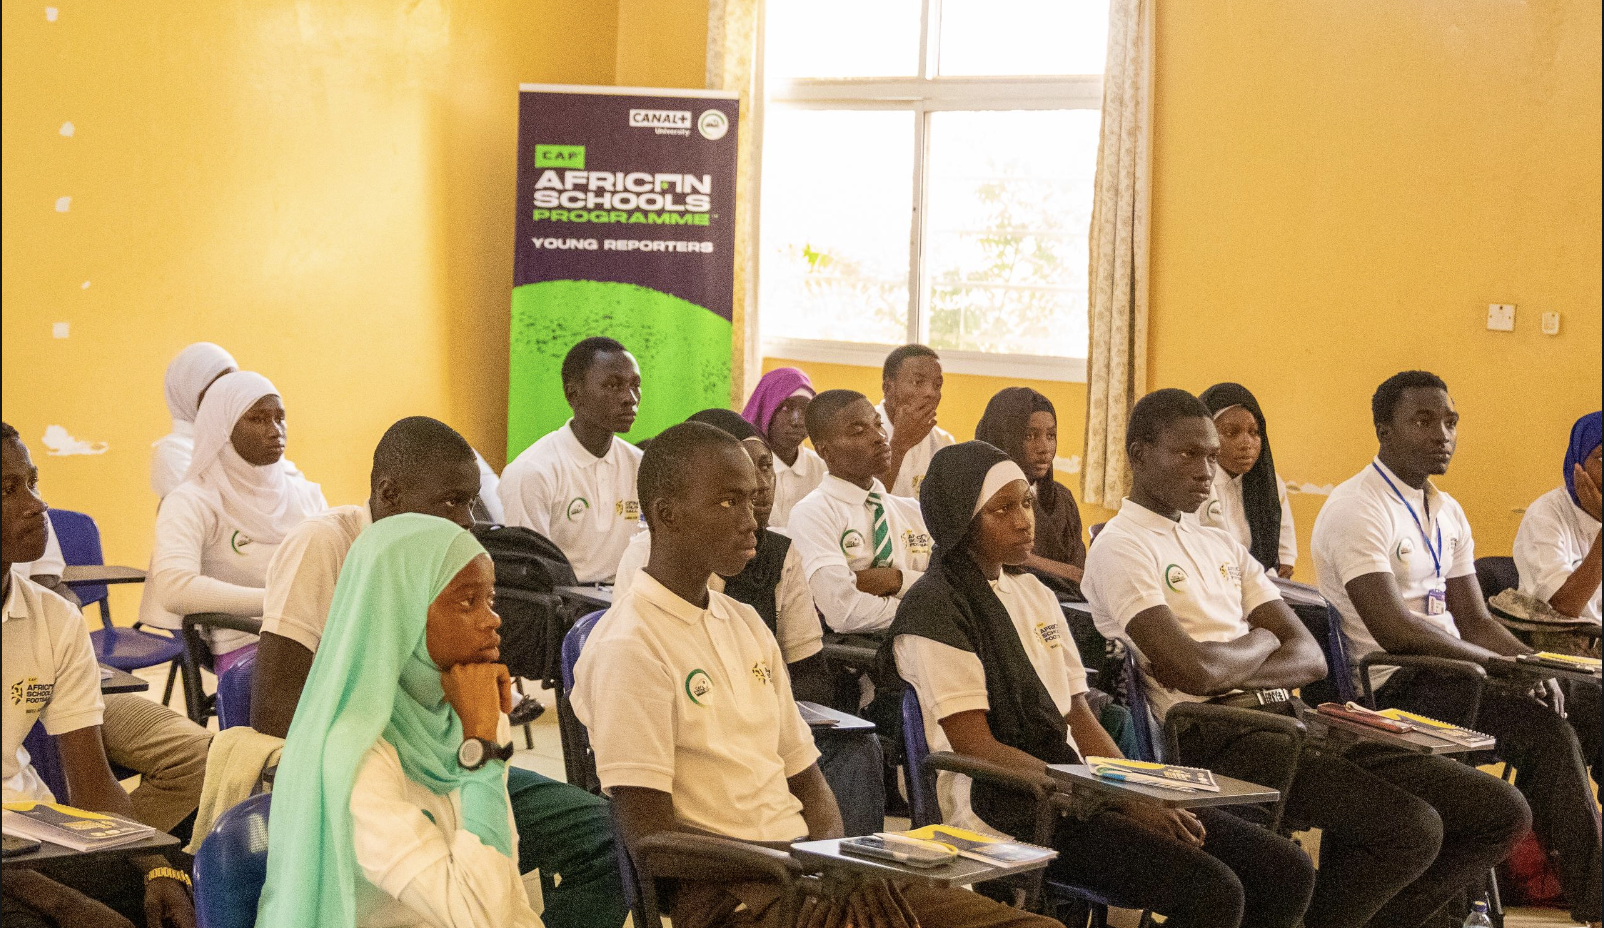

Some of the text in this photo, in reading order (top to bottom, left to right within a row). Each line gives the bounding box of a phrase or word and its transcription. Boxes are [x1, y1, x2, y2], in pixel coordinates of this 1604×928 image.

[633, 112, 687, 124] CANAL+
[655, 127, 690, 137] University
[542, 150, 577, 160] CAF
[534, 169, 712, 195] AFRICAN
[533, 190, 711, 213] SCHOOLS
[532, 209, 711, 227] PROGRAMME
[532, 237, 714, 254] YOUNG REPORTERS
